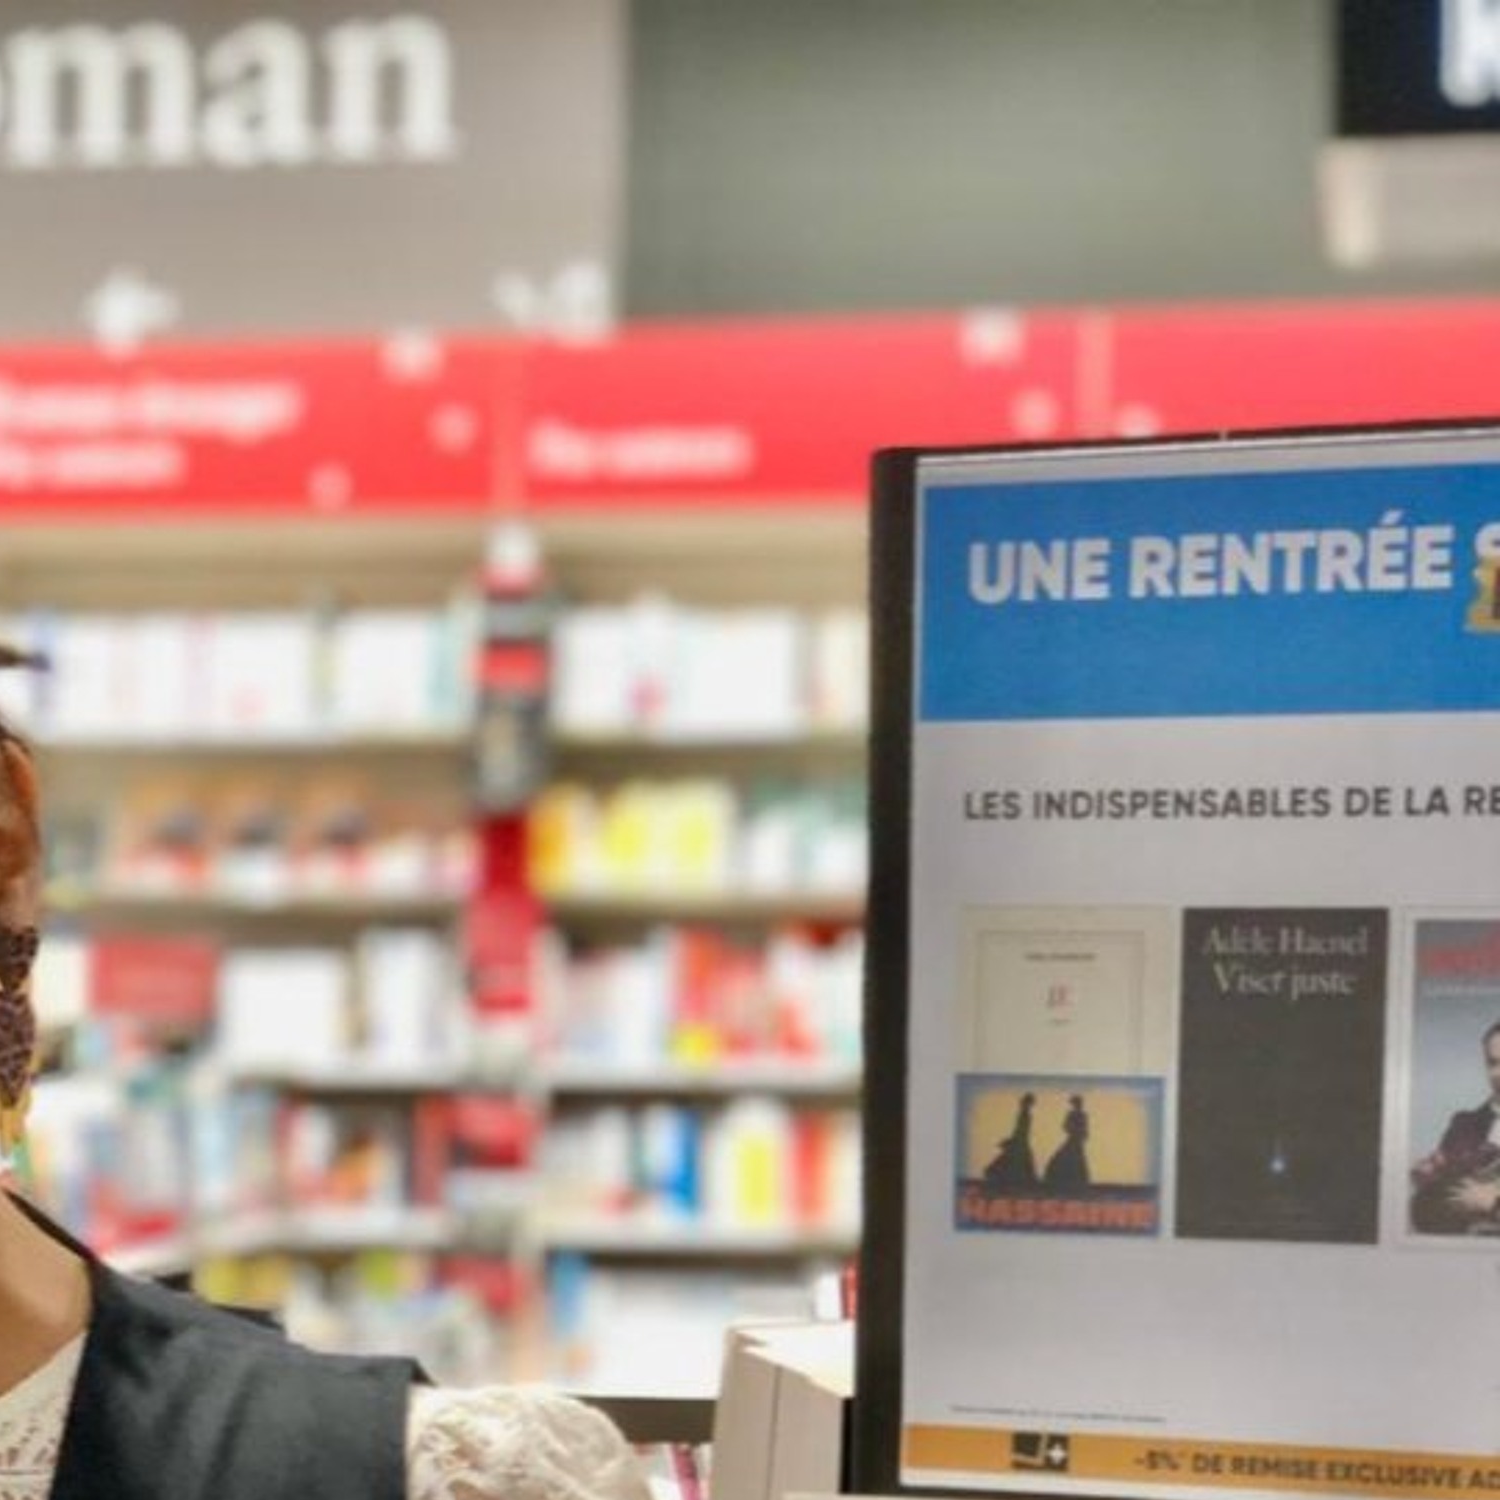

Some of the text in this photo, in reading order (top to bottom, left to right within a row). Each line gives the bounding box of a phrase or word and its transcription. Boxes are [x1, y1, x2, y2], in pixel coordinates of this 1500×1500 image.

[968, 537, 1112, 604] UNE
[1127, 509, 1455, 599] RENTRÉE
[964, 790, 1022, 820] LES
[1032, 787, 1333, 820] INDISPENSABLES
[1344, 786, 1392, 817] DE
[1404, 785, 1450, 817] LA
[1191, 1452, 1223, 1474] DE
[1231, 1455, 1318, 1481] REMISE
[1326, 1460, 1463, 1490] EXCLUSIVE
